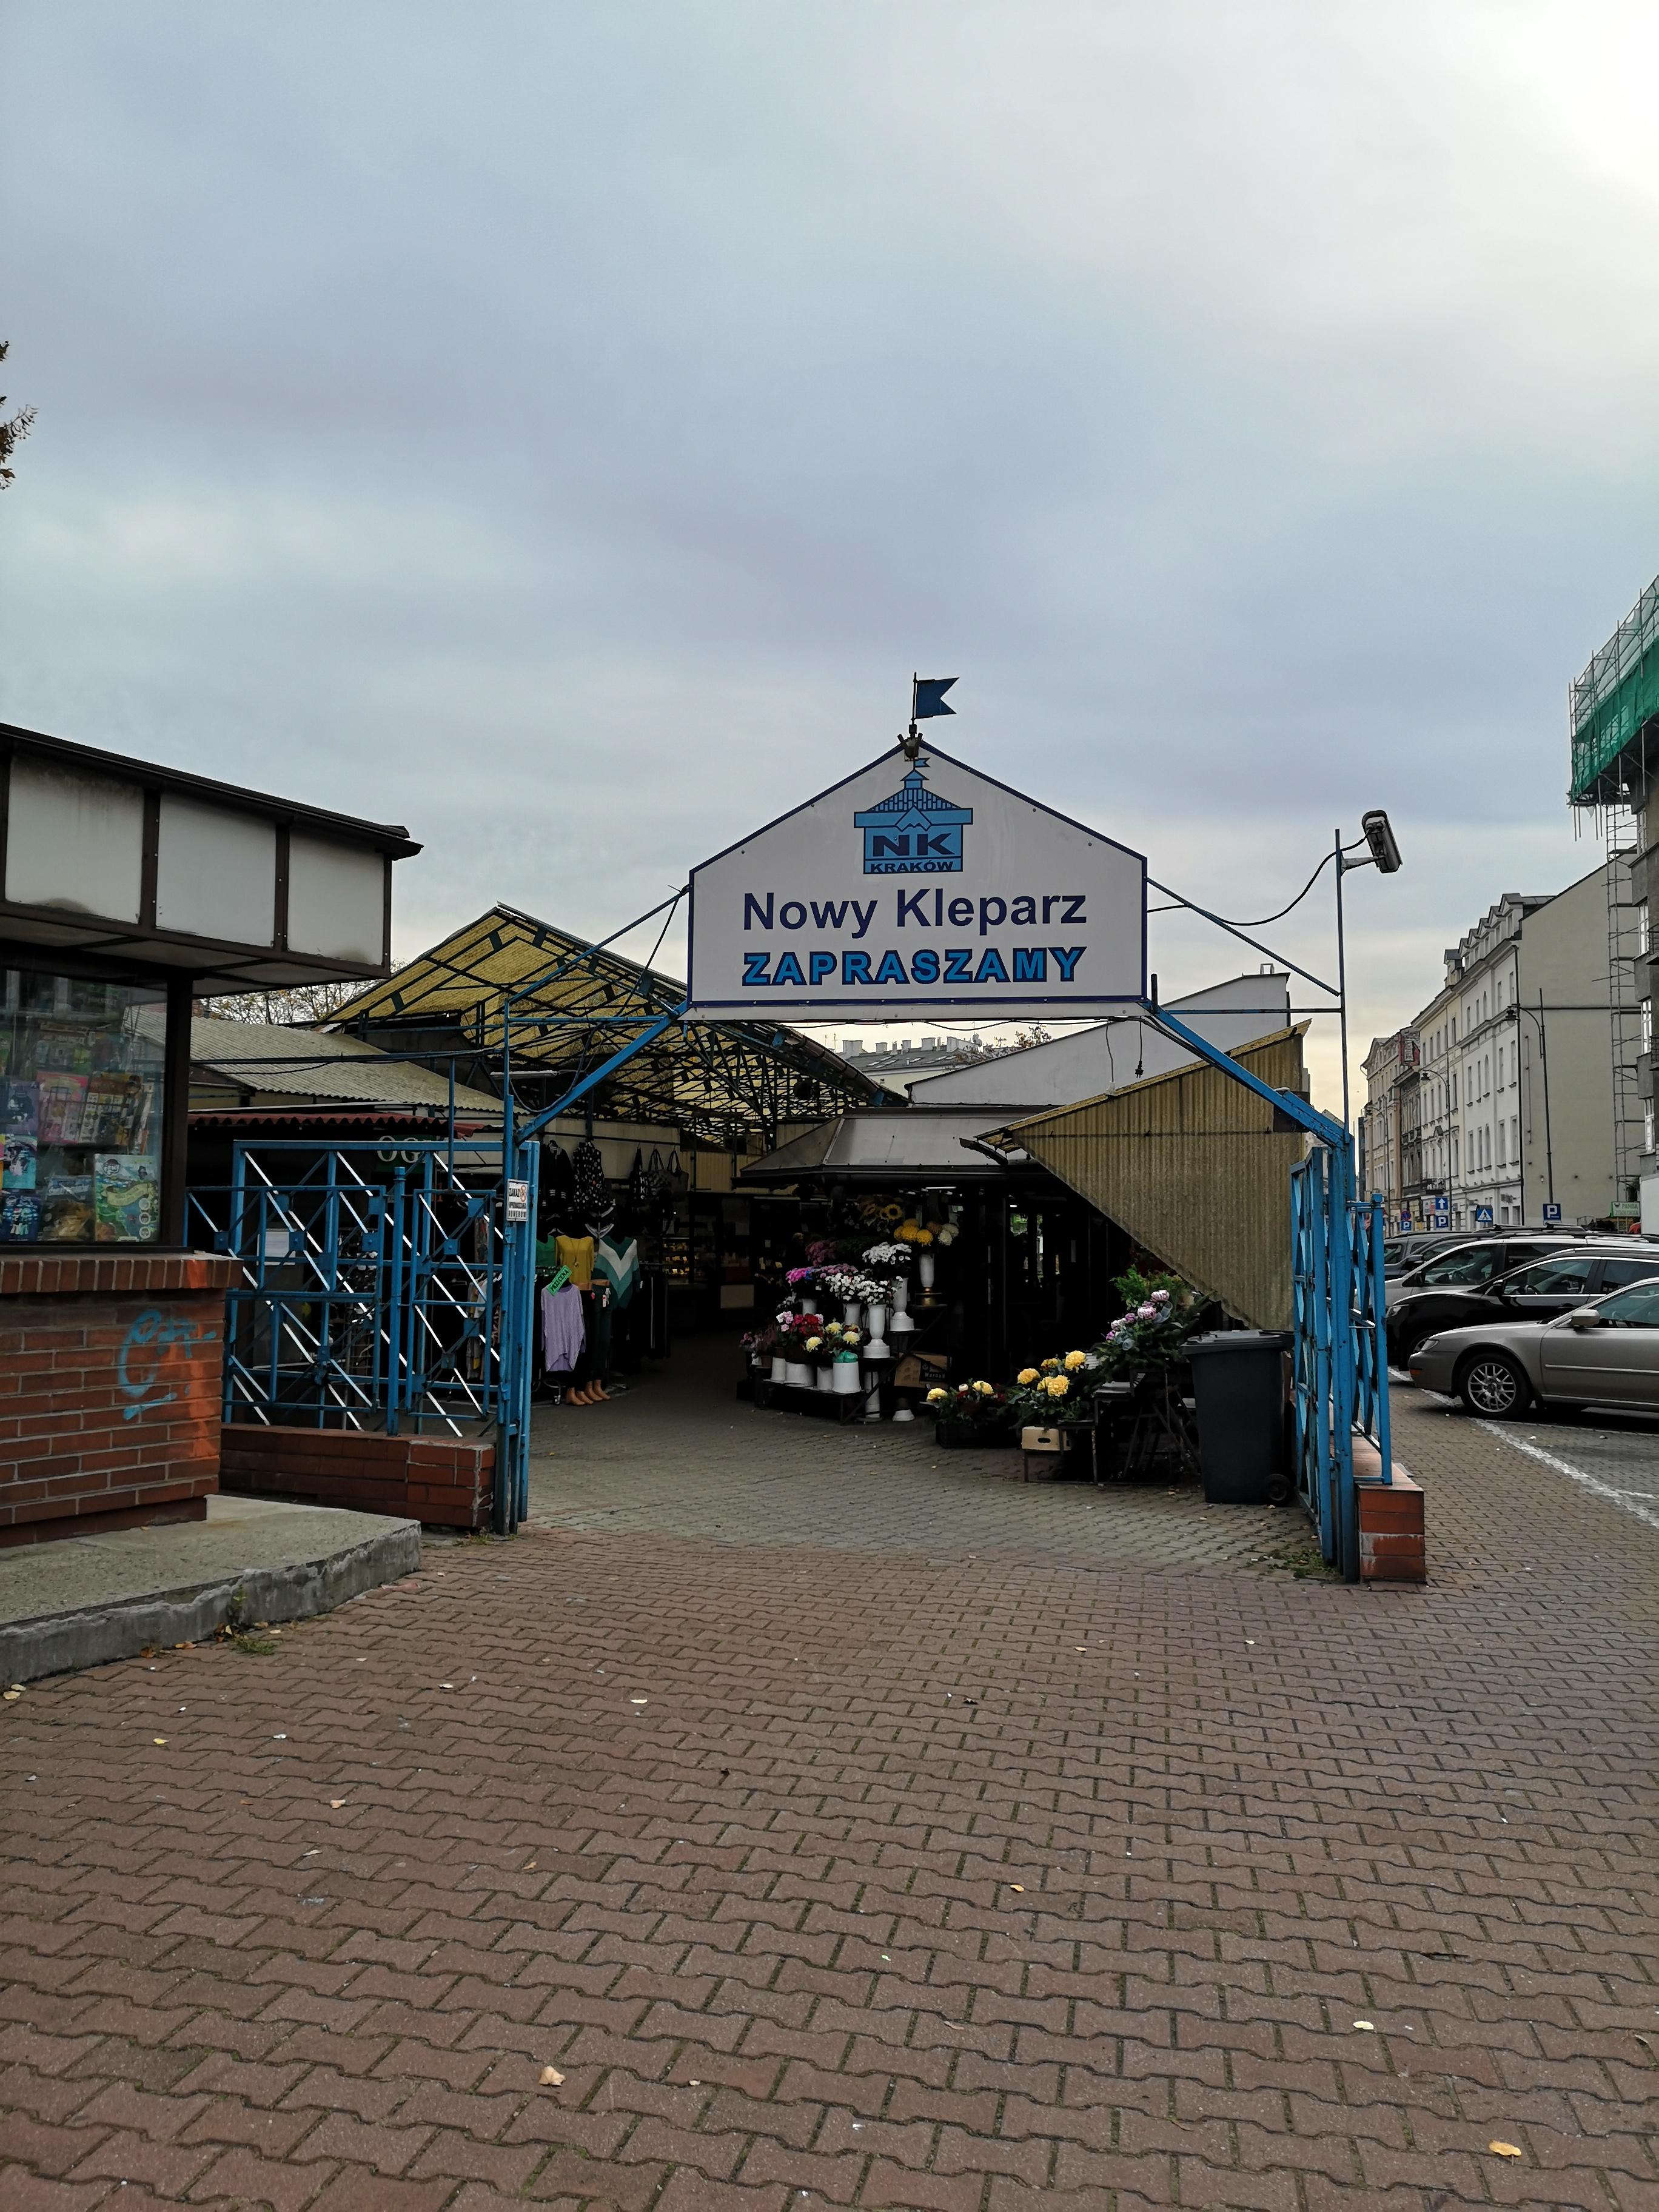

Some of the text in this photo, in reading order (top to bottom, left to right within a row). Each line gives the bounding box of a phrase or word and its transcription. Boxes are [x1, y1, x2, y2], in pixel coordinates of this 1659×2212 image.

[873, 833, 955, 857] NK
[871, 860, 954, 873] KRAKÓW
[743, 888, 1087, 939] Nowy Kleparz
[742, 946, 1087, 987] ZAPRASZAMY
[509, 1188, 520, 1198] ZAKAZ
[508, 1208, 527, 1218] ROWERÓW
[1547, 1205, 1558, 1218] P
[1438, 1216, 1447, 1227] P
